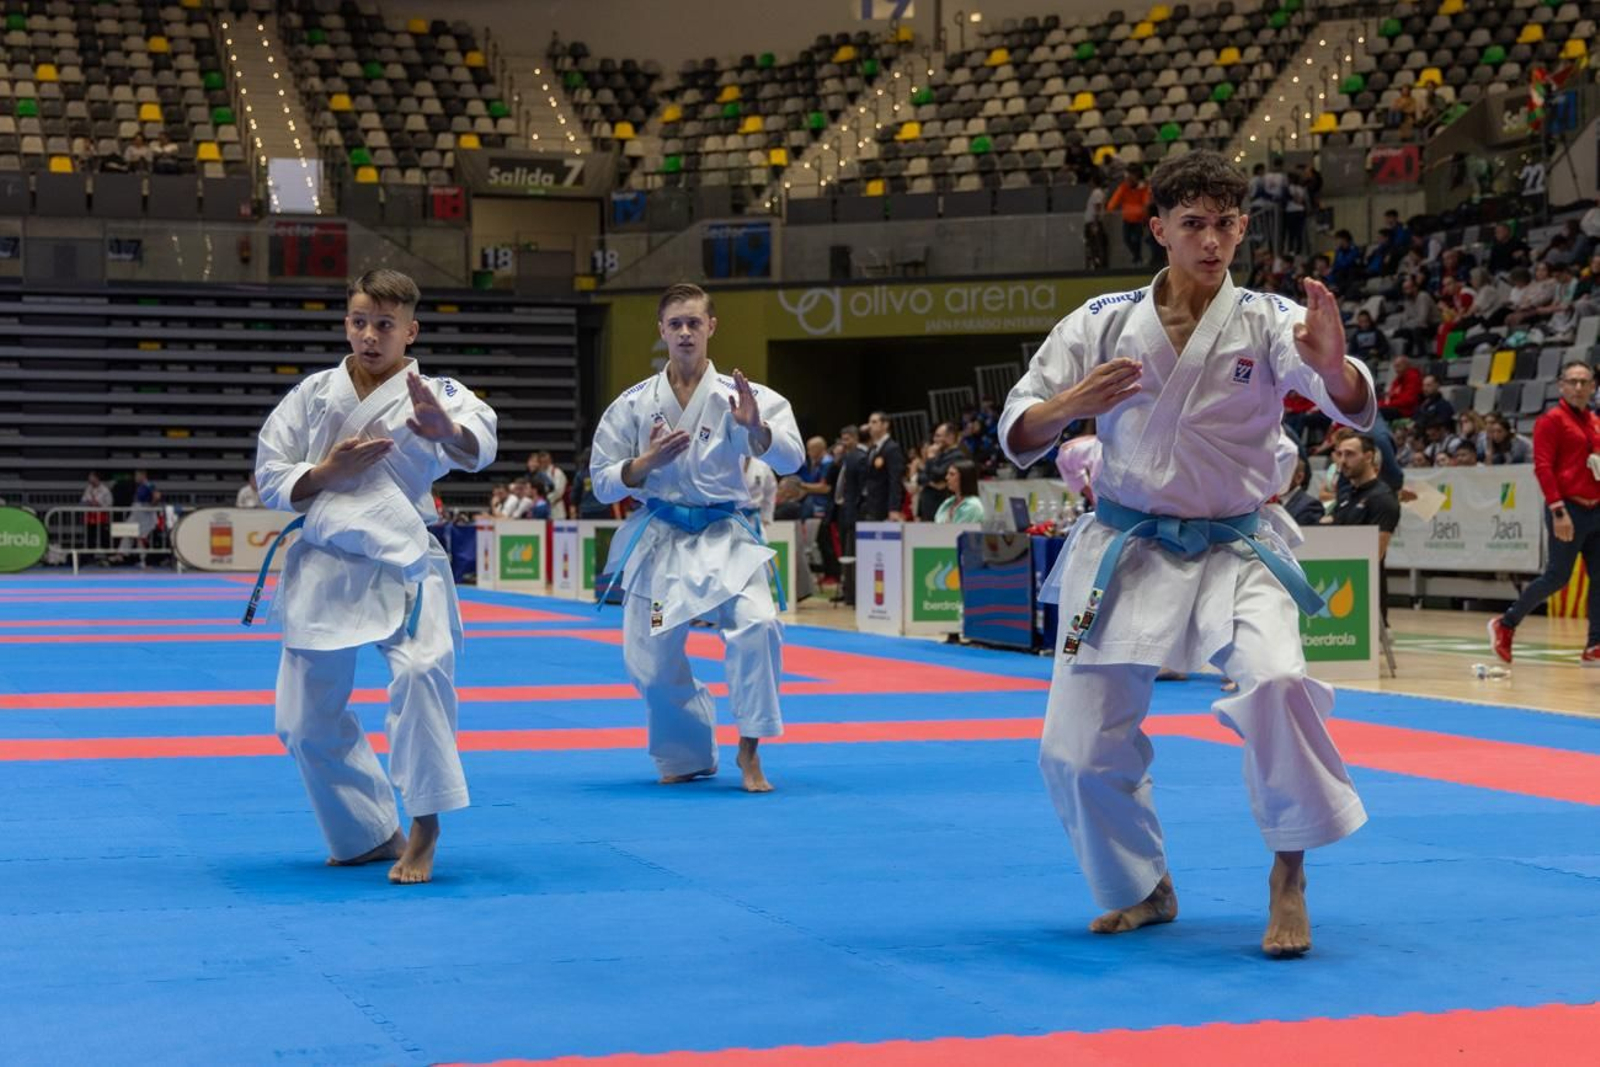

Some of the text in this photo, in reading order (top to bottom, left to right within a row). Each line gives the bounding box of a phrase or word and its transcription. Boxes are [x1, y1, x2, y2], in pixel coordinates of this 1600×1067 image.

[488, 158, 585, 187] Salida 7
[483, 248, 513, 270] 18
[592, 249, 620, 272] 18
[849, 282, 1056, 317] olivo arena
[0, 531, 40, 547] drola
